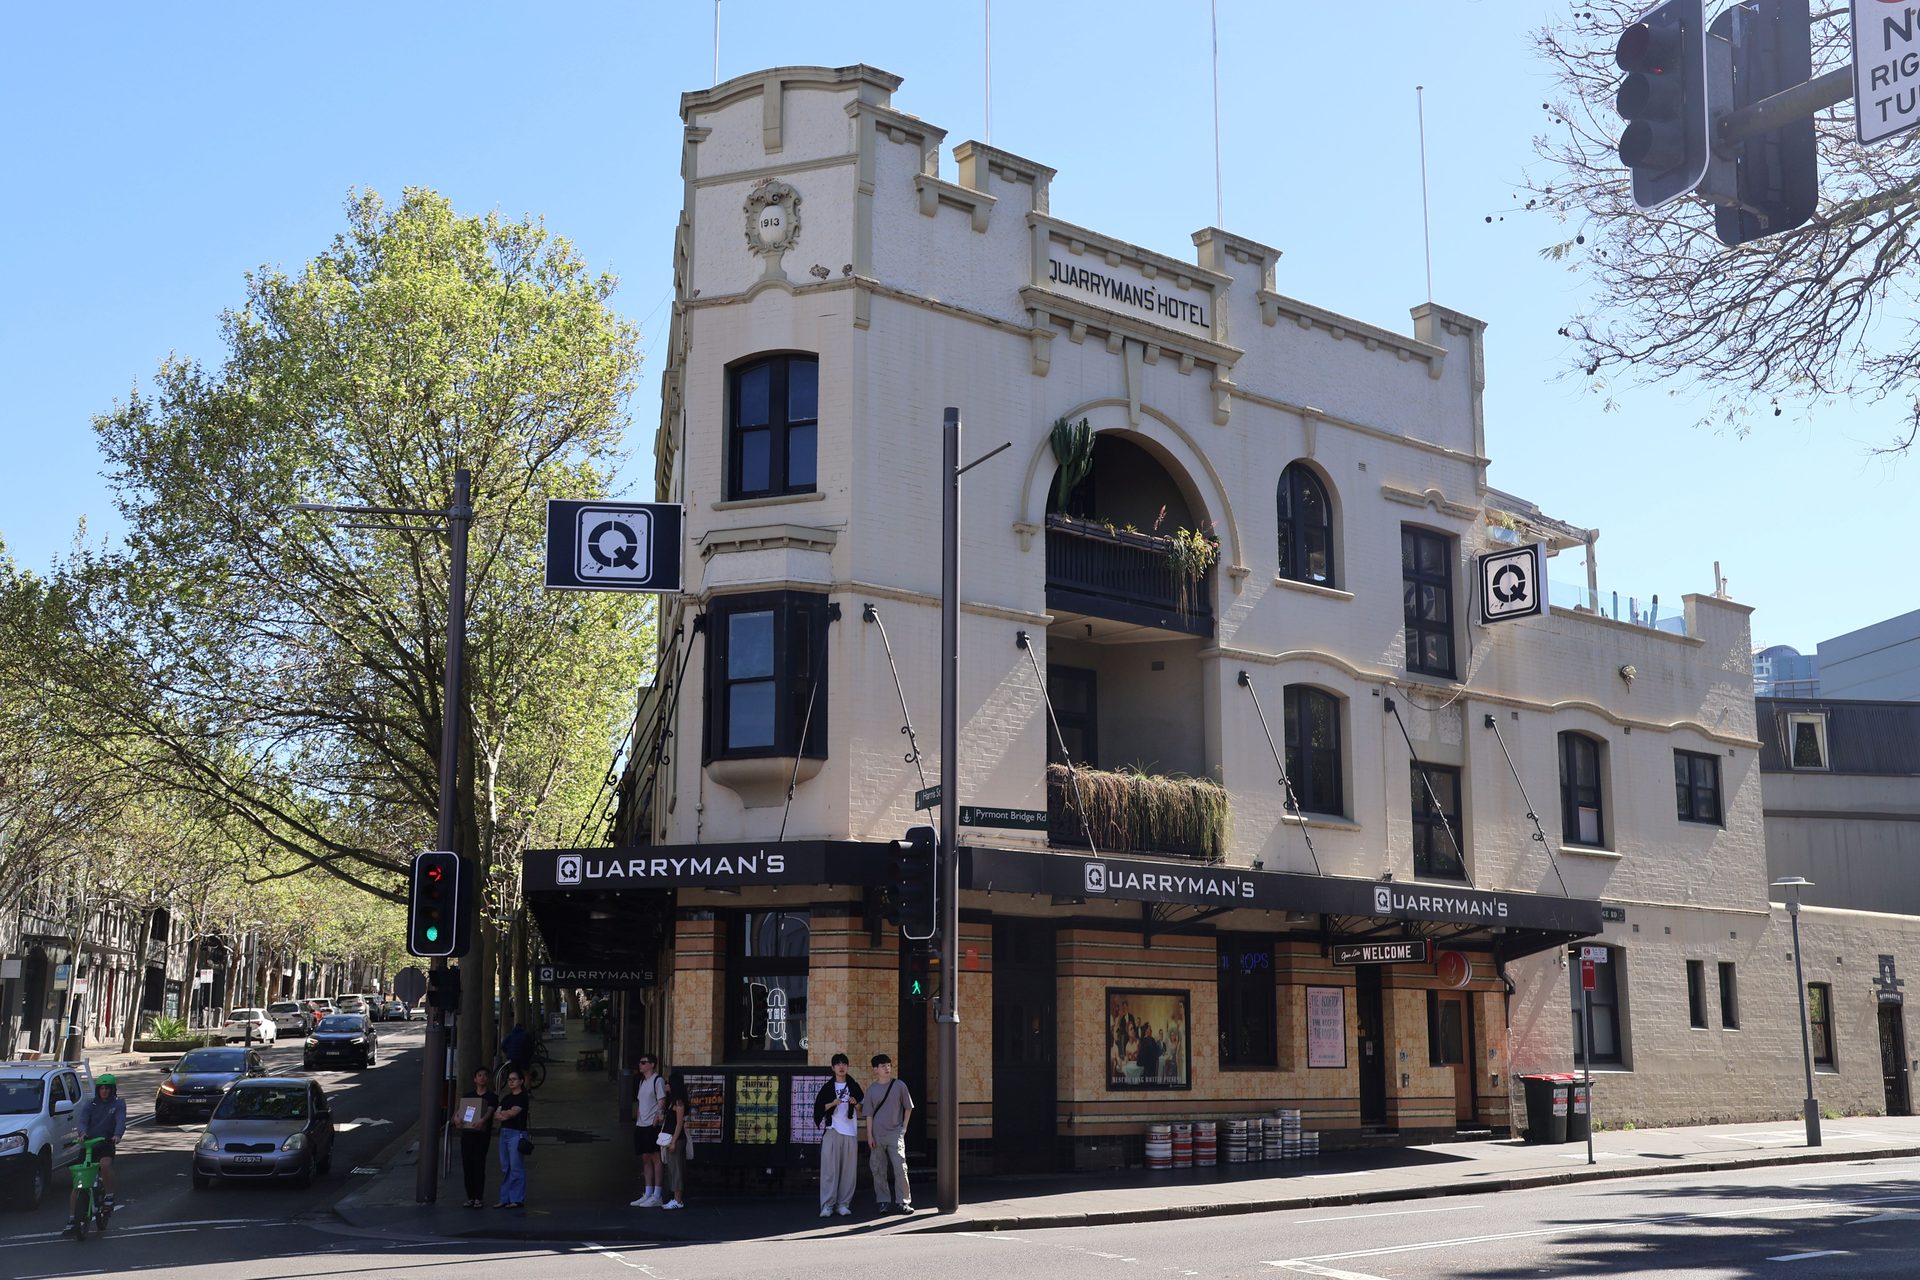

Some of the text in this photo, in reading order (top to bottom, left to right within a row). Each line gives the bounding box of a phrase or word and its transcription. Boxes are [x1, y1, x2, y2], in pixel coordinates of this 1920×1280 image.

[1883, 7, 1920, 51] N
[1875, 84, 1920, 122] TU
[760, 217, 780, 228] 1913
[1158, 294, 1209, 328] HOTEL
[588, 520, 639, 571] Q
[1492, 564, 1528, 602] Q
[976, 808, 1047, 822] Pyrmont Bridge Rd
[1362, 945, 1412, 960] WELCOME
[767, 1008, 786, 1019] THE
